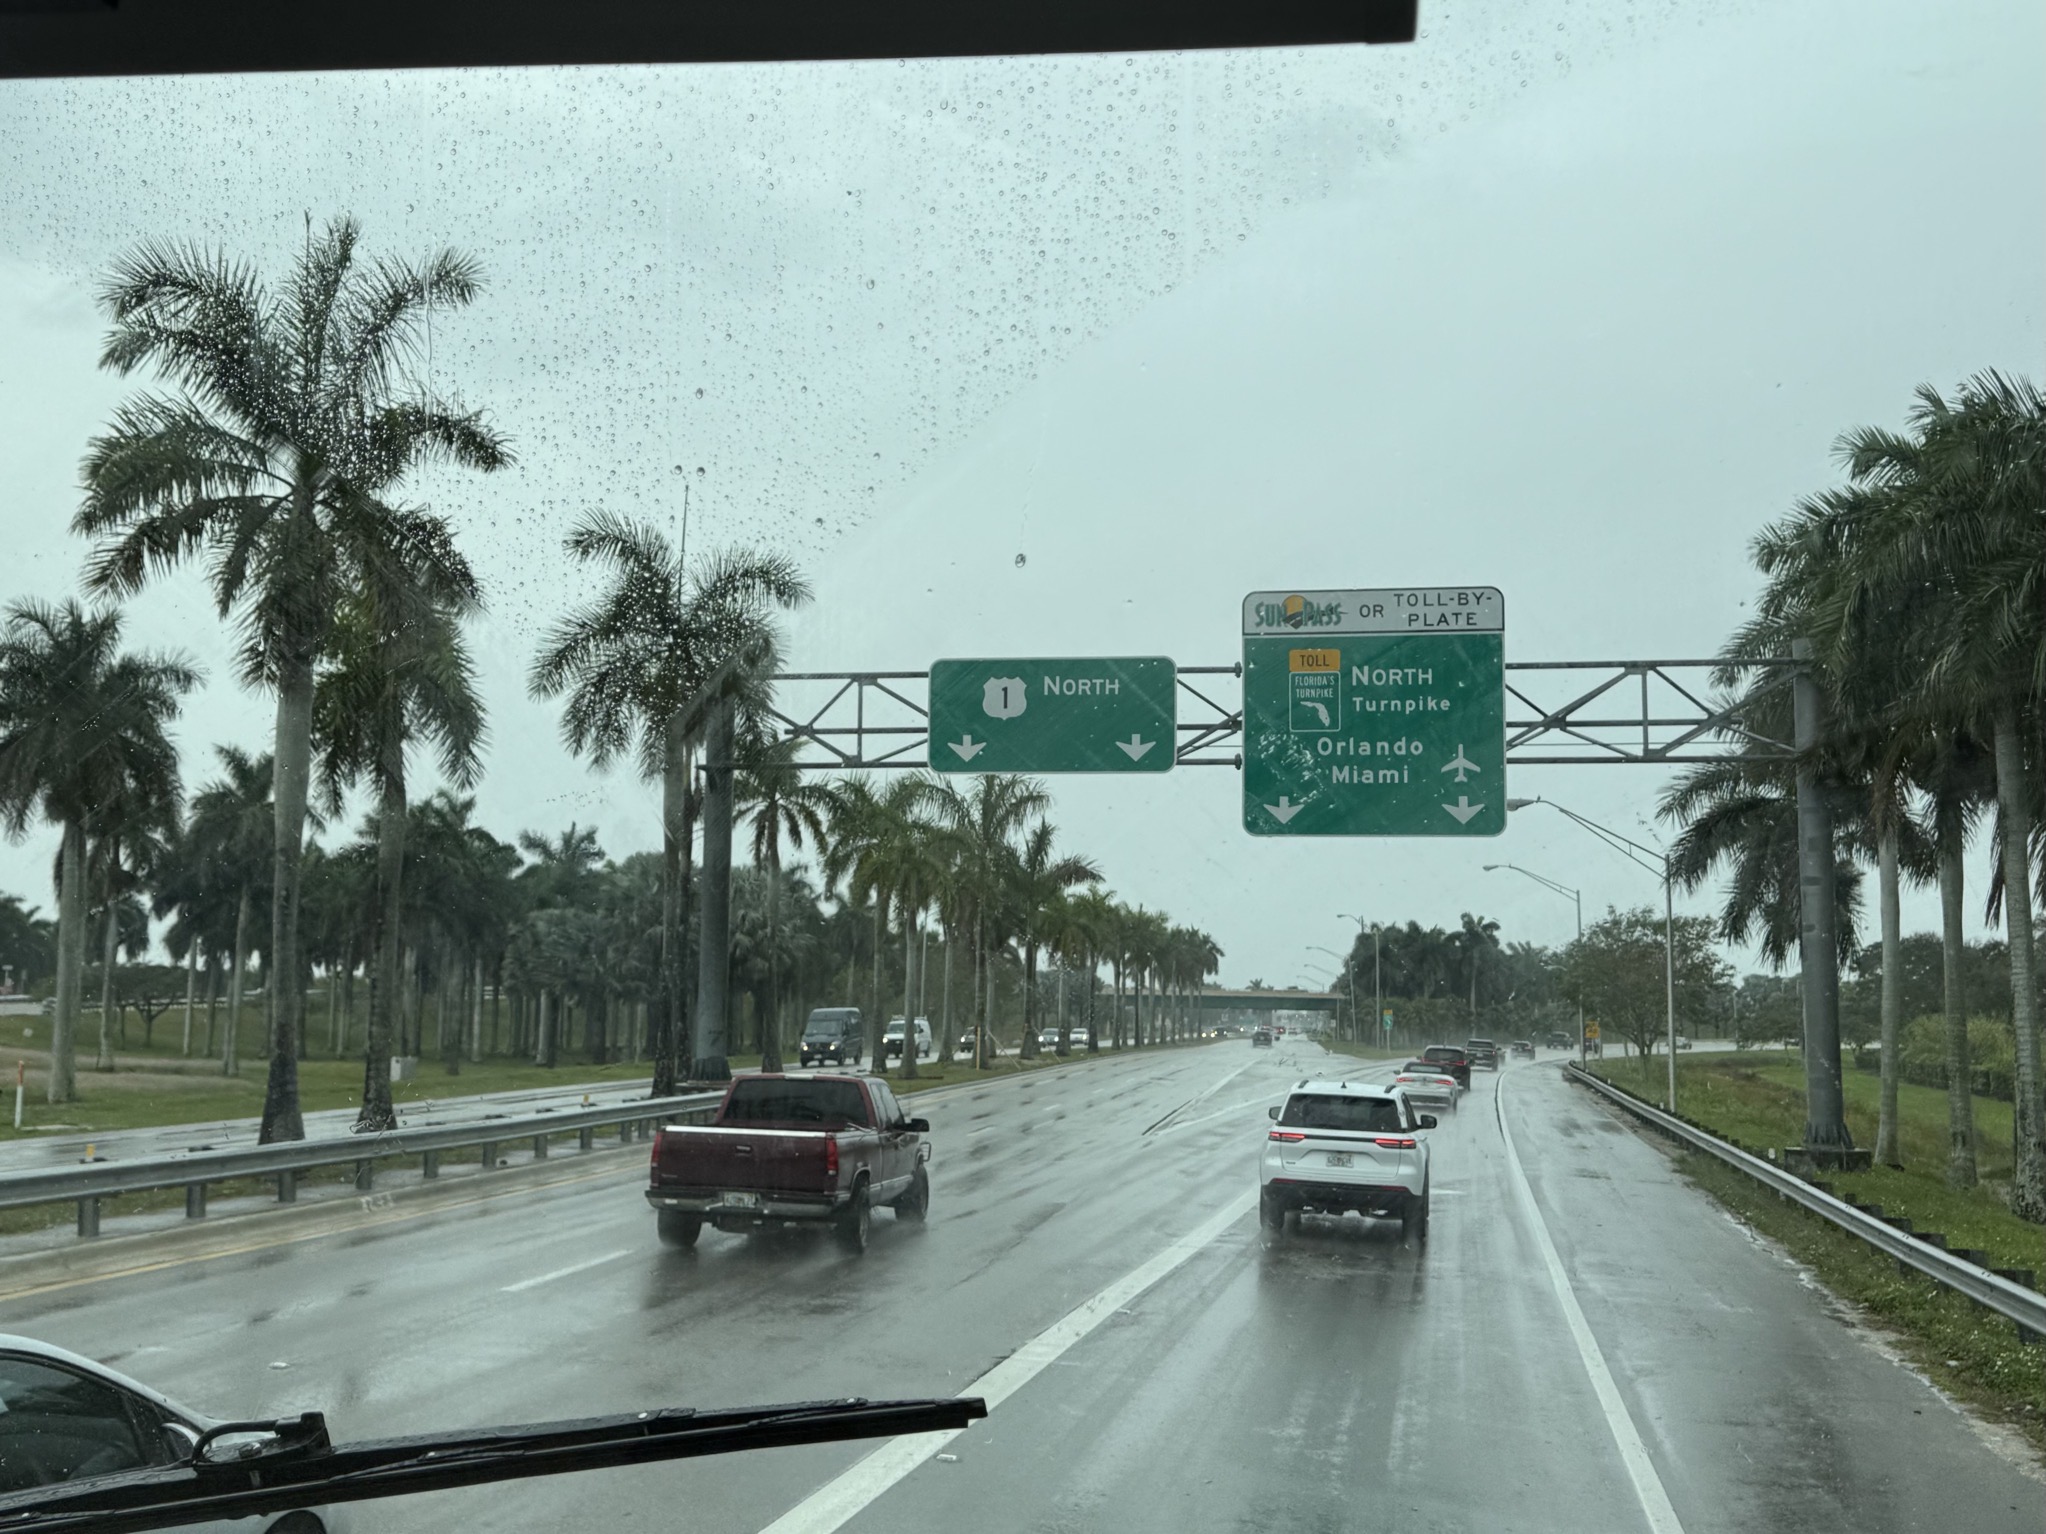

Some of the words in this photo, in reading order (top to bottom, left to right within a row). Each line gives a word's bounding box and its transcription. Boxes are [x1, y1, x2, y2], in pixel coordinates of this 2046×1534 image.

[1393, 592, 1492, 607] TOLL-BY-
[1359, 604, 1384, 618] OR
[1408, 612, 1477, 627] PLATE
[1300, 654, 1329, 667] TOLL
[1294, 675, 1335, 686] FLORIDA'S
[1352, 666, 1432, 686] NORTH
[1043, 675, 1120, 696] NORTH
[1296, 688, 1334, 698] TURNPIKE
[1001, 686, 1009, 709] 1
[1352, 696, 1451, 714] Turnpike
[1317, 736, 1423, 756] Orlando
[1332, 765, 1409, 784] Miami
